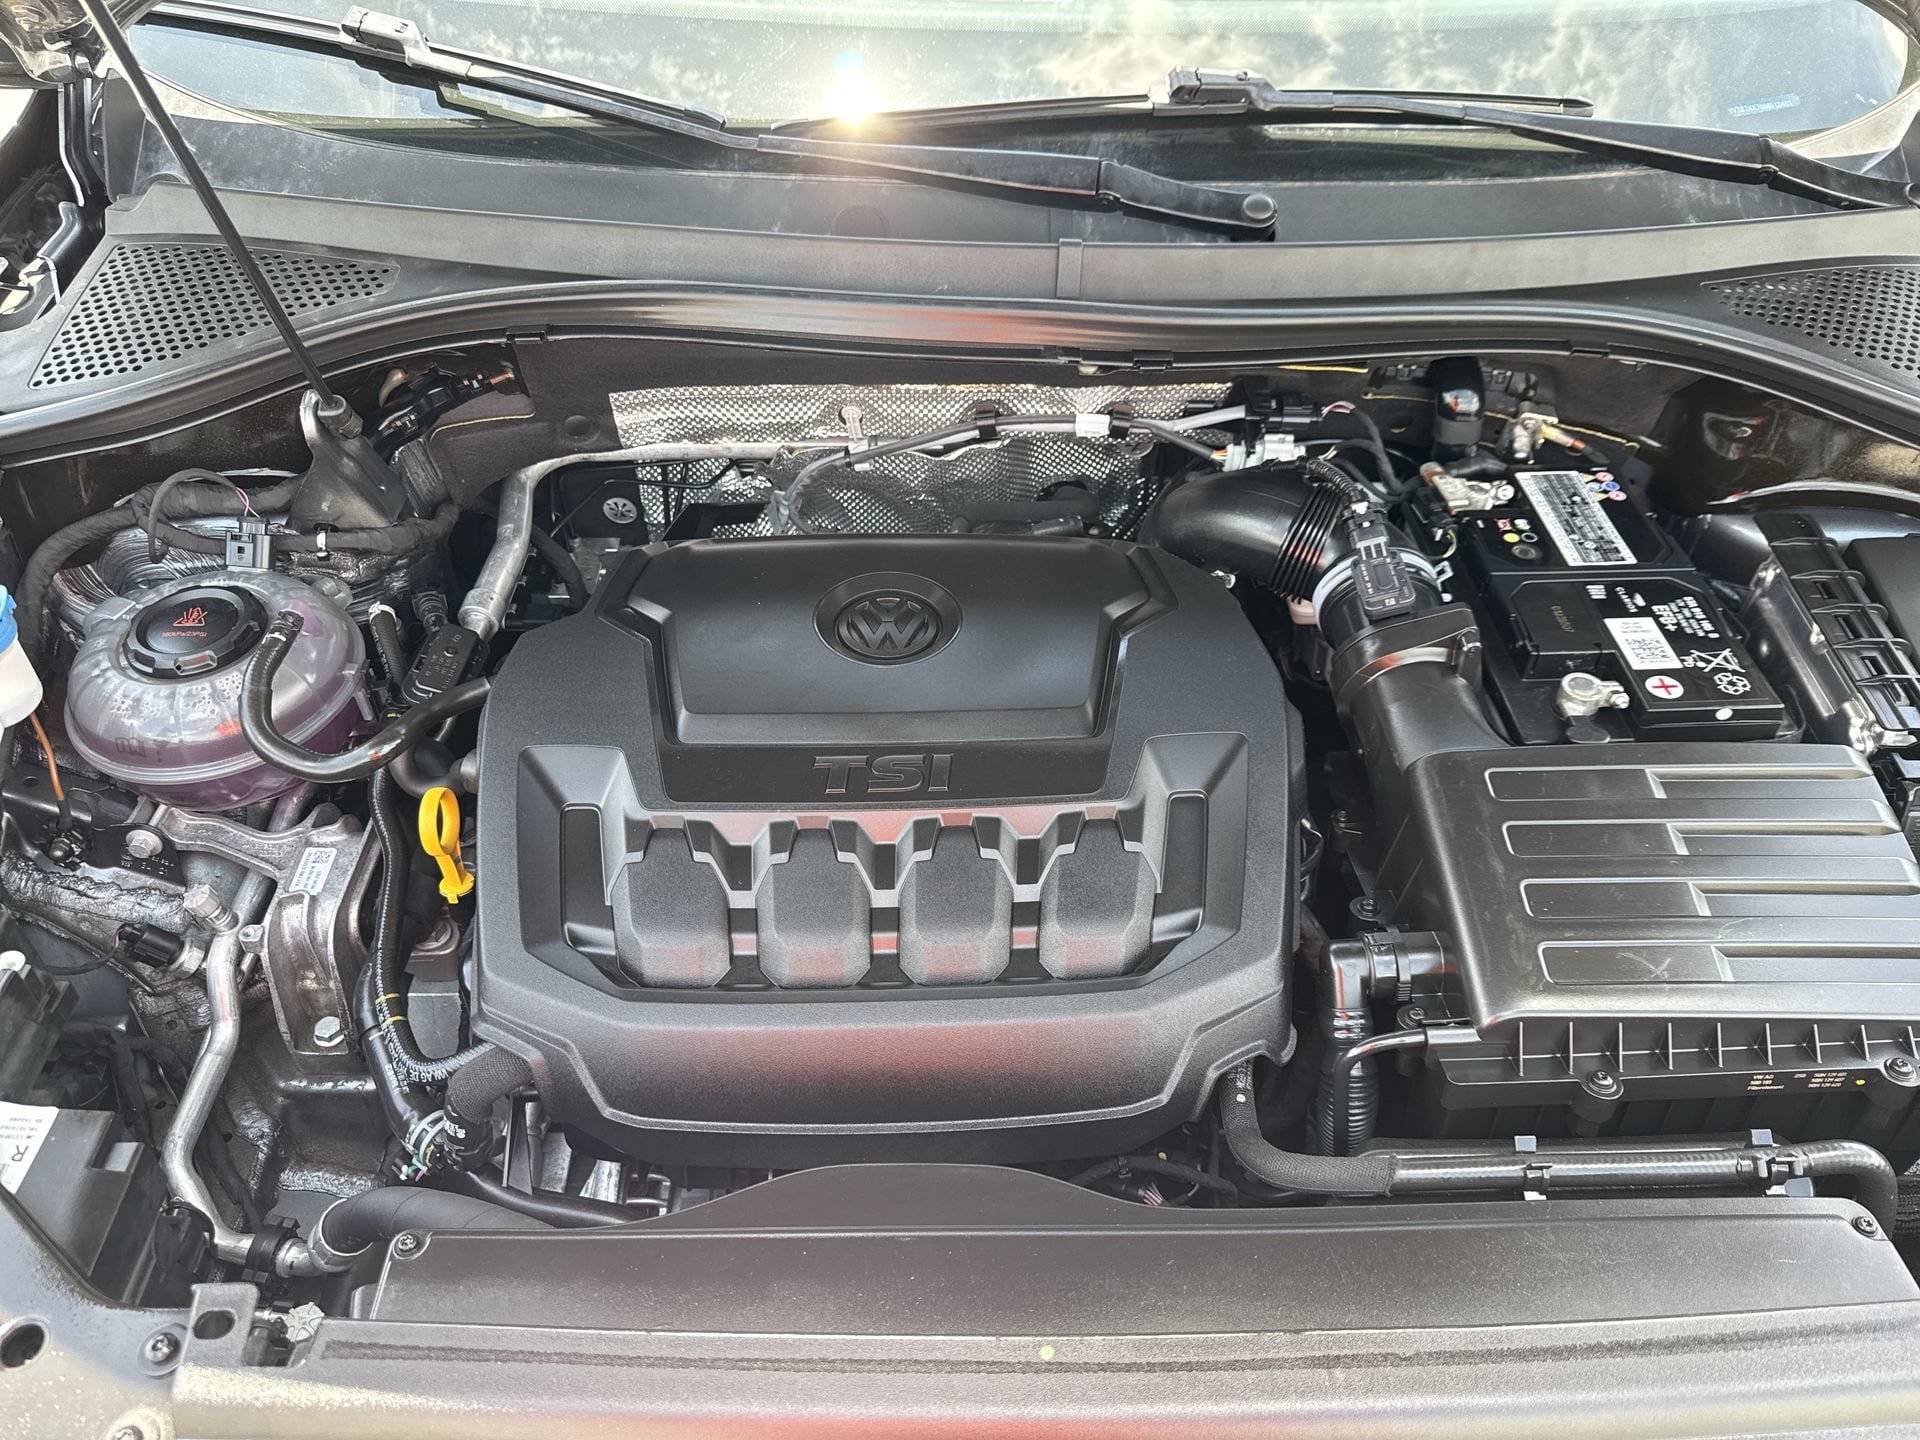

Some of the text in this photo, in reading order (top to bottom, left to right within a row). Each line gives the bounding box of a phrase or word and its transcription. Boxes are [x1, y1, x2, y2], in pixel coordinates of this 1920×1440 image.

[838, 590, 938, 657] VW
[1650, 604, 1679, 632] EFB+
[1679, 655, 1696, 668] Pb
[813, 754, 954, 794] TSI
[11, 1144, 29, 1162] R
